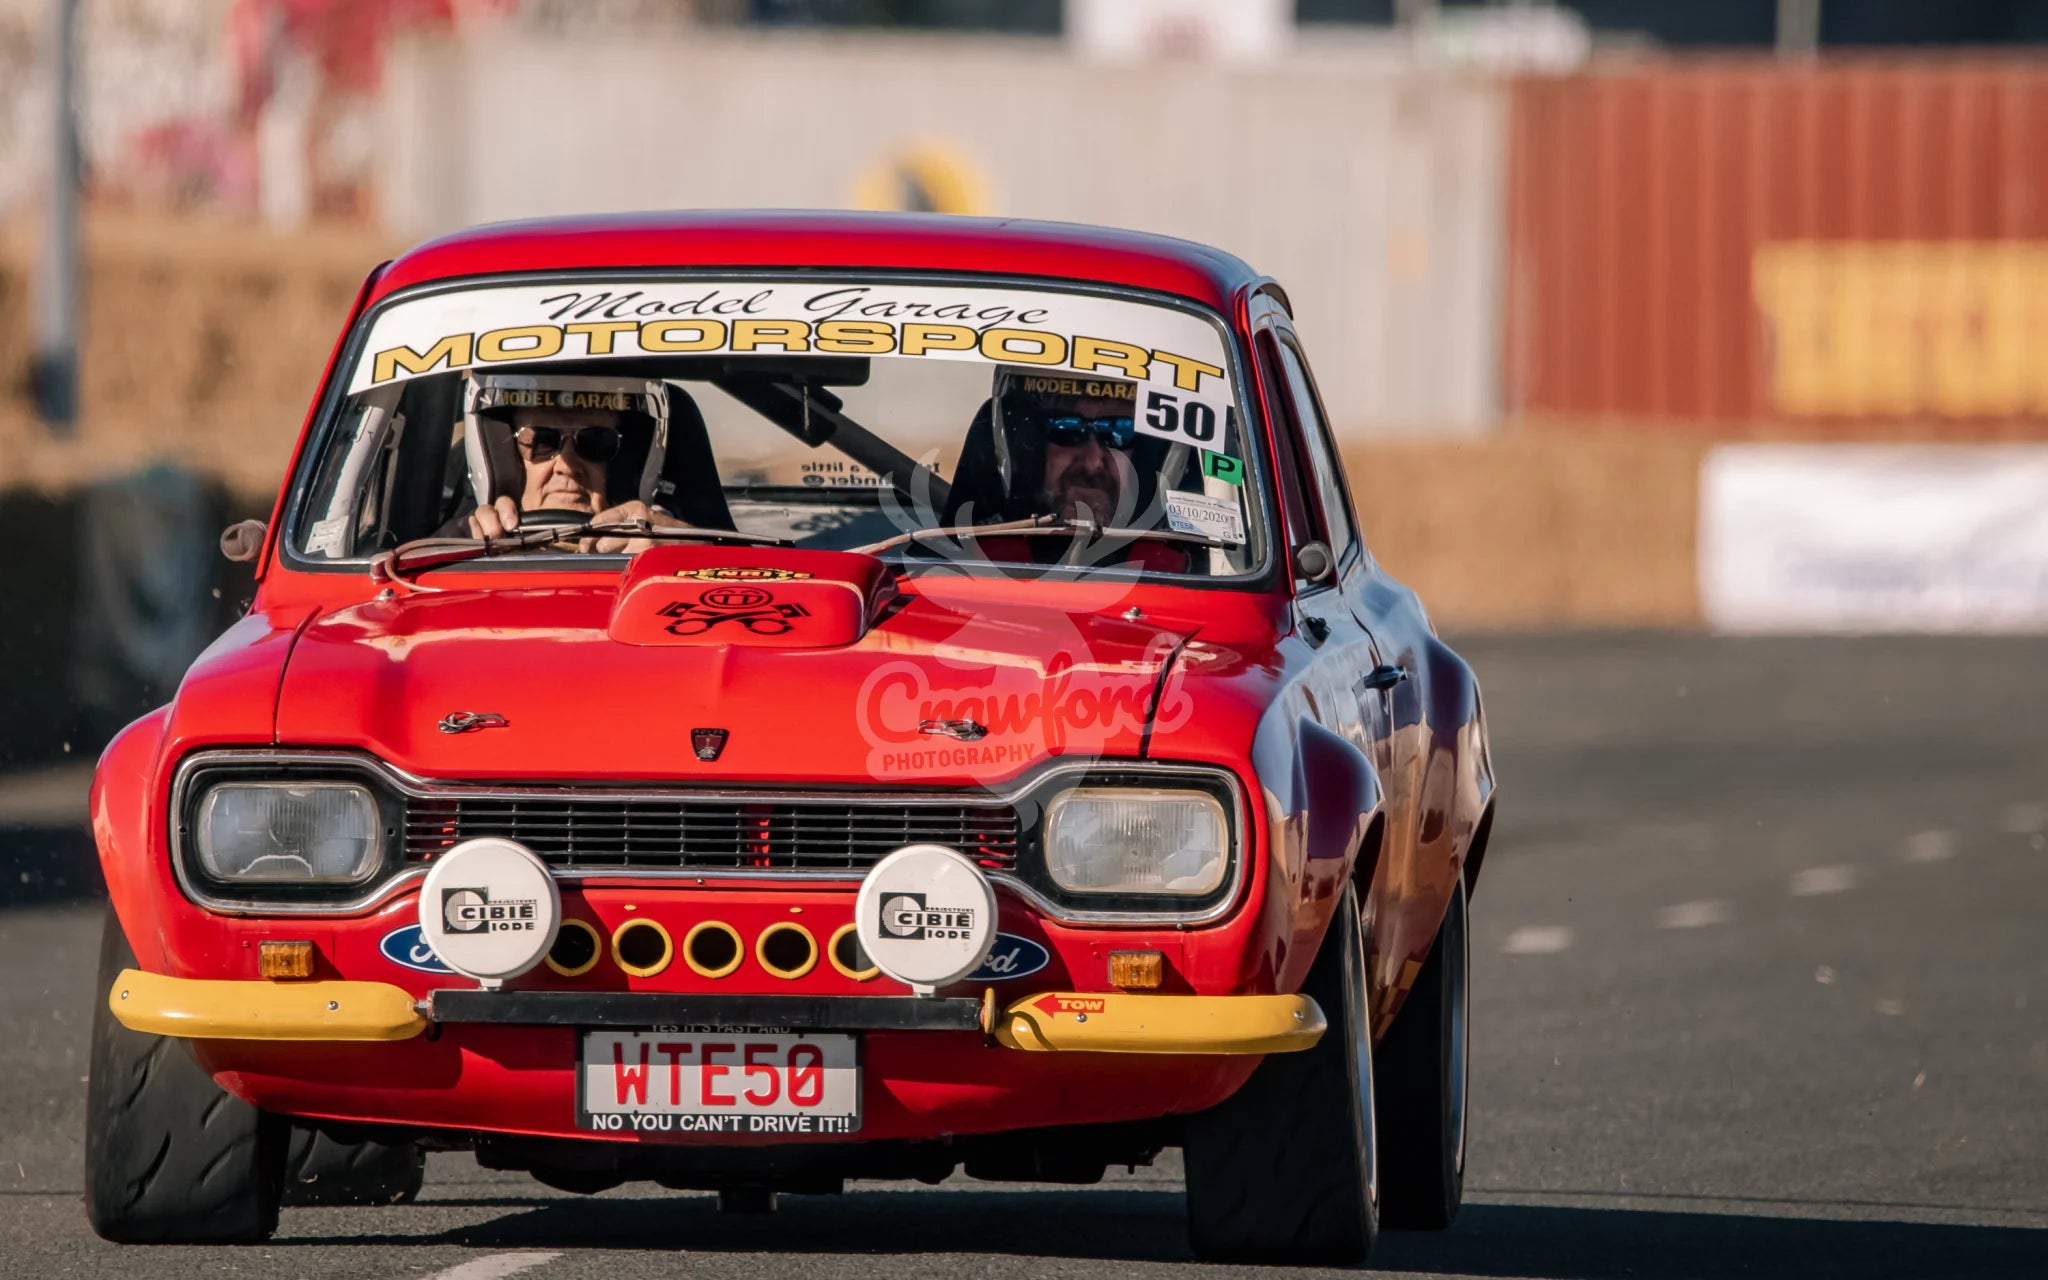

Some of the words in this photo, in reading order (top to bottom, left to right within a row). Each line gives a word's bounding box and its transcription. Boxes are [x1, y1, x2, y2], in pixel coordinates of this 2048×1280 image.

[540, 289, 773, 320] Model
[803, 288, 1048, 330] Garage
[373, 319, 1224, 393] MOTORSPORT
[1025, 377, 1082, 395] MODEL
[1086, 382, 1137, 399] GARA
[500, 391, 554, 406] MODEL
[558, 391, 631, 410] GARAGE
[1146, 391, 1215, 442] 50
[1211, 455, 1235, 477] P
[1169, 504, 1228, 524] 03/10/2020
[492, 922, 534, 931] IODE
[928, 929, 970, 939] IODE
[1058, 999, 1103, 1011] TOW
[758, 1024, 791, 1034] AND
[613, 1042, 824, 1106] WTE50
[592, 1115, 623, 1130] NO
[630, 1115, 672, 1131] YOU
[679, 1115, 742, 1132] CAN'T
[750, 1116, 811, 1132] DRIVE
[818, 1117, 850, 1133] IT!!
